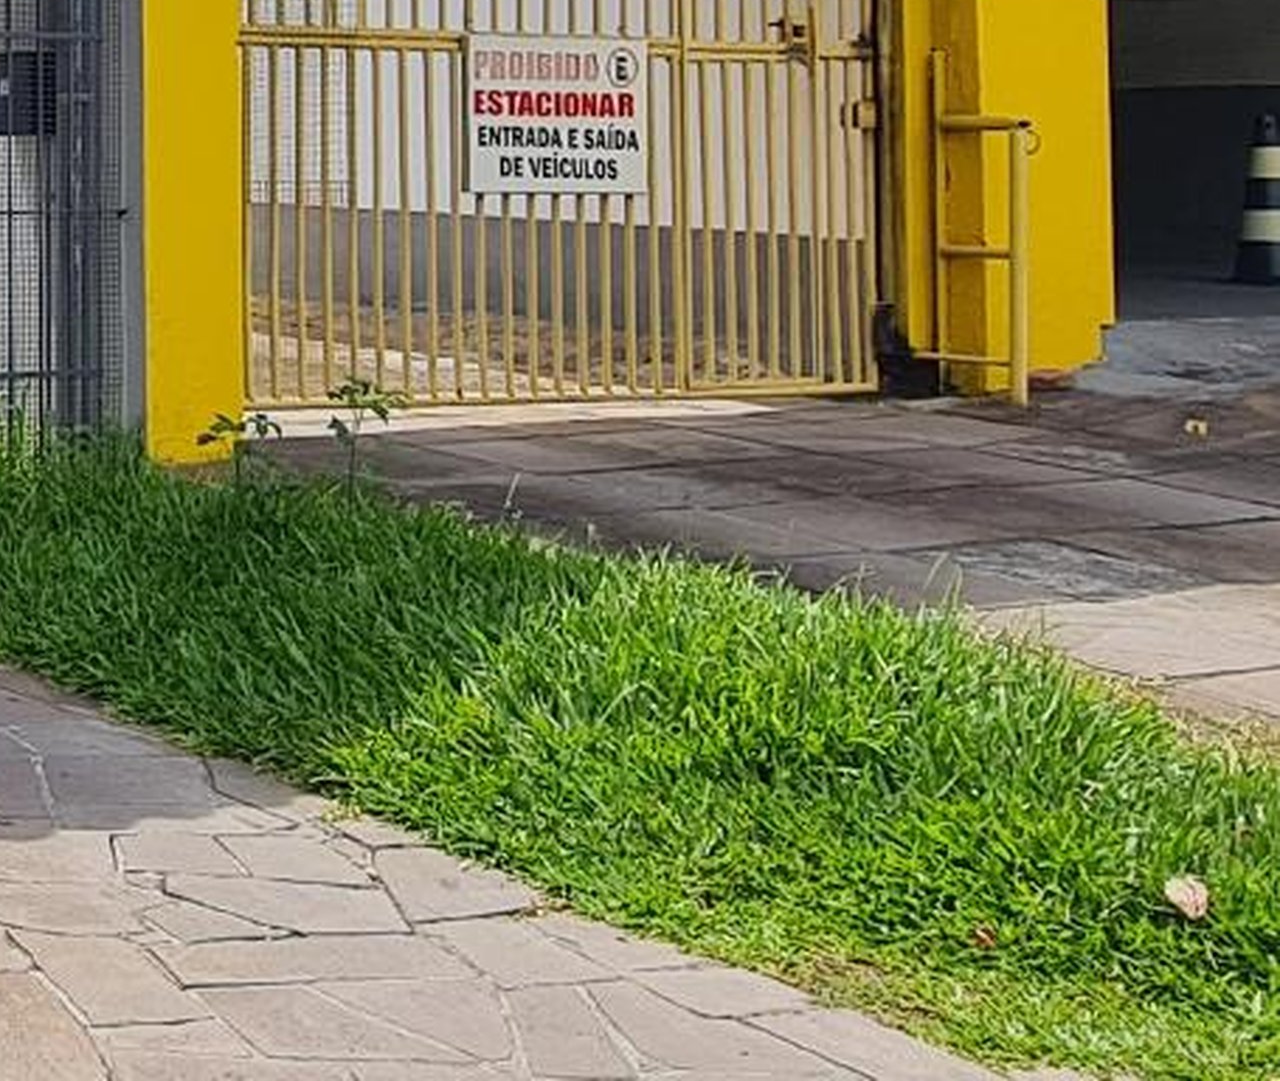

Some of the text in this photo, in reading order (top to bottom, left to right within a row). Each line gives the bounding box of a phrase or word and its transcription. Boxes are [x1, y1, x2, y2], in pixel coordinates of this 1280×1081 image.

[474, 50, 600, 82] PROIBIDO
[473, 89, 635, 118] ESTACIONAR
[477, 122, 640, 152] ENTRADA E SAÍDA
[499, 151, 618, 180] DE VEÍCULOS
